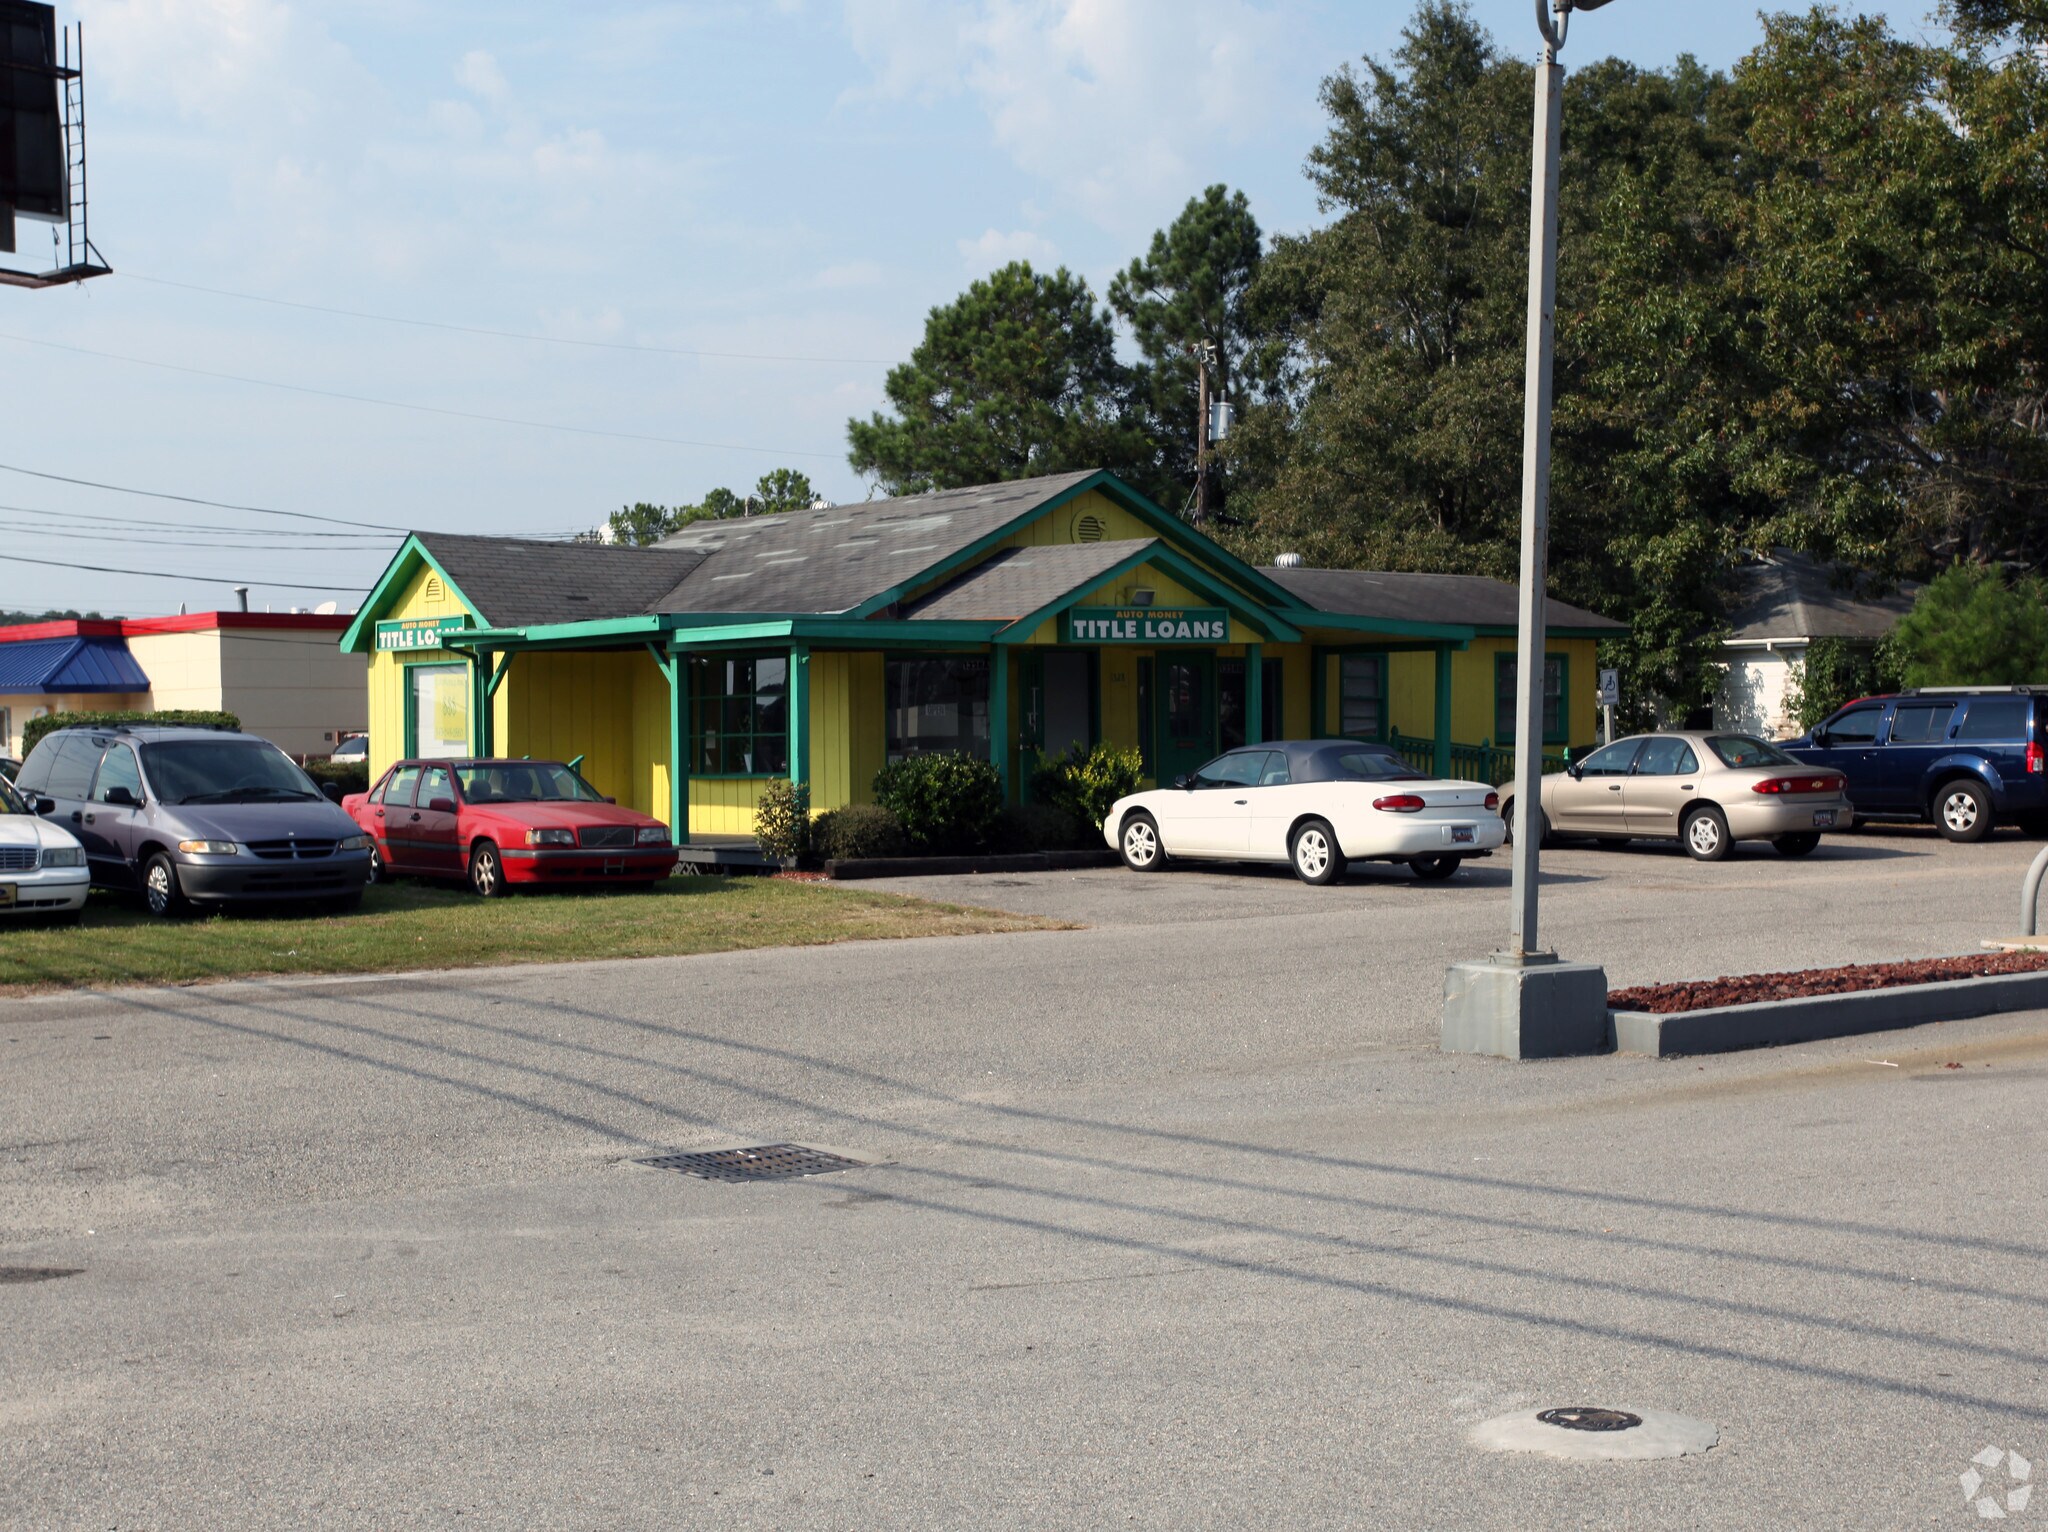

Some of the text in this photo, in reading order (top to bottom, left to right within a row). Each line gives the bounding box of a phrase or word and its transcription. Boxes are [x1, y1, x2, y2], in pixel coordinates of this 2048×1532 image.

[1116, 611, 1184, 619] AUTO MONEY
[419, 620, 440, 628] MONEY
[1073, 620, 1224, 639] TITLE LOANS
[379, 630, 413, 648] TITLE
